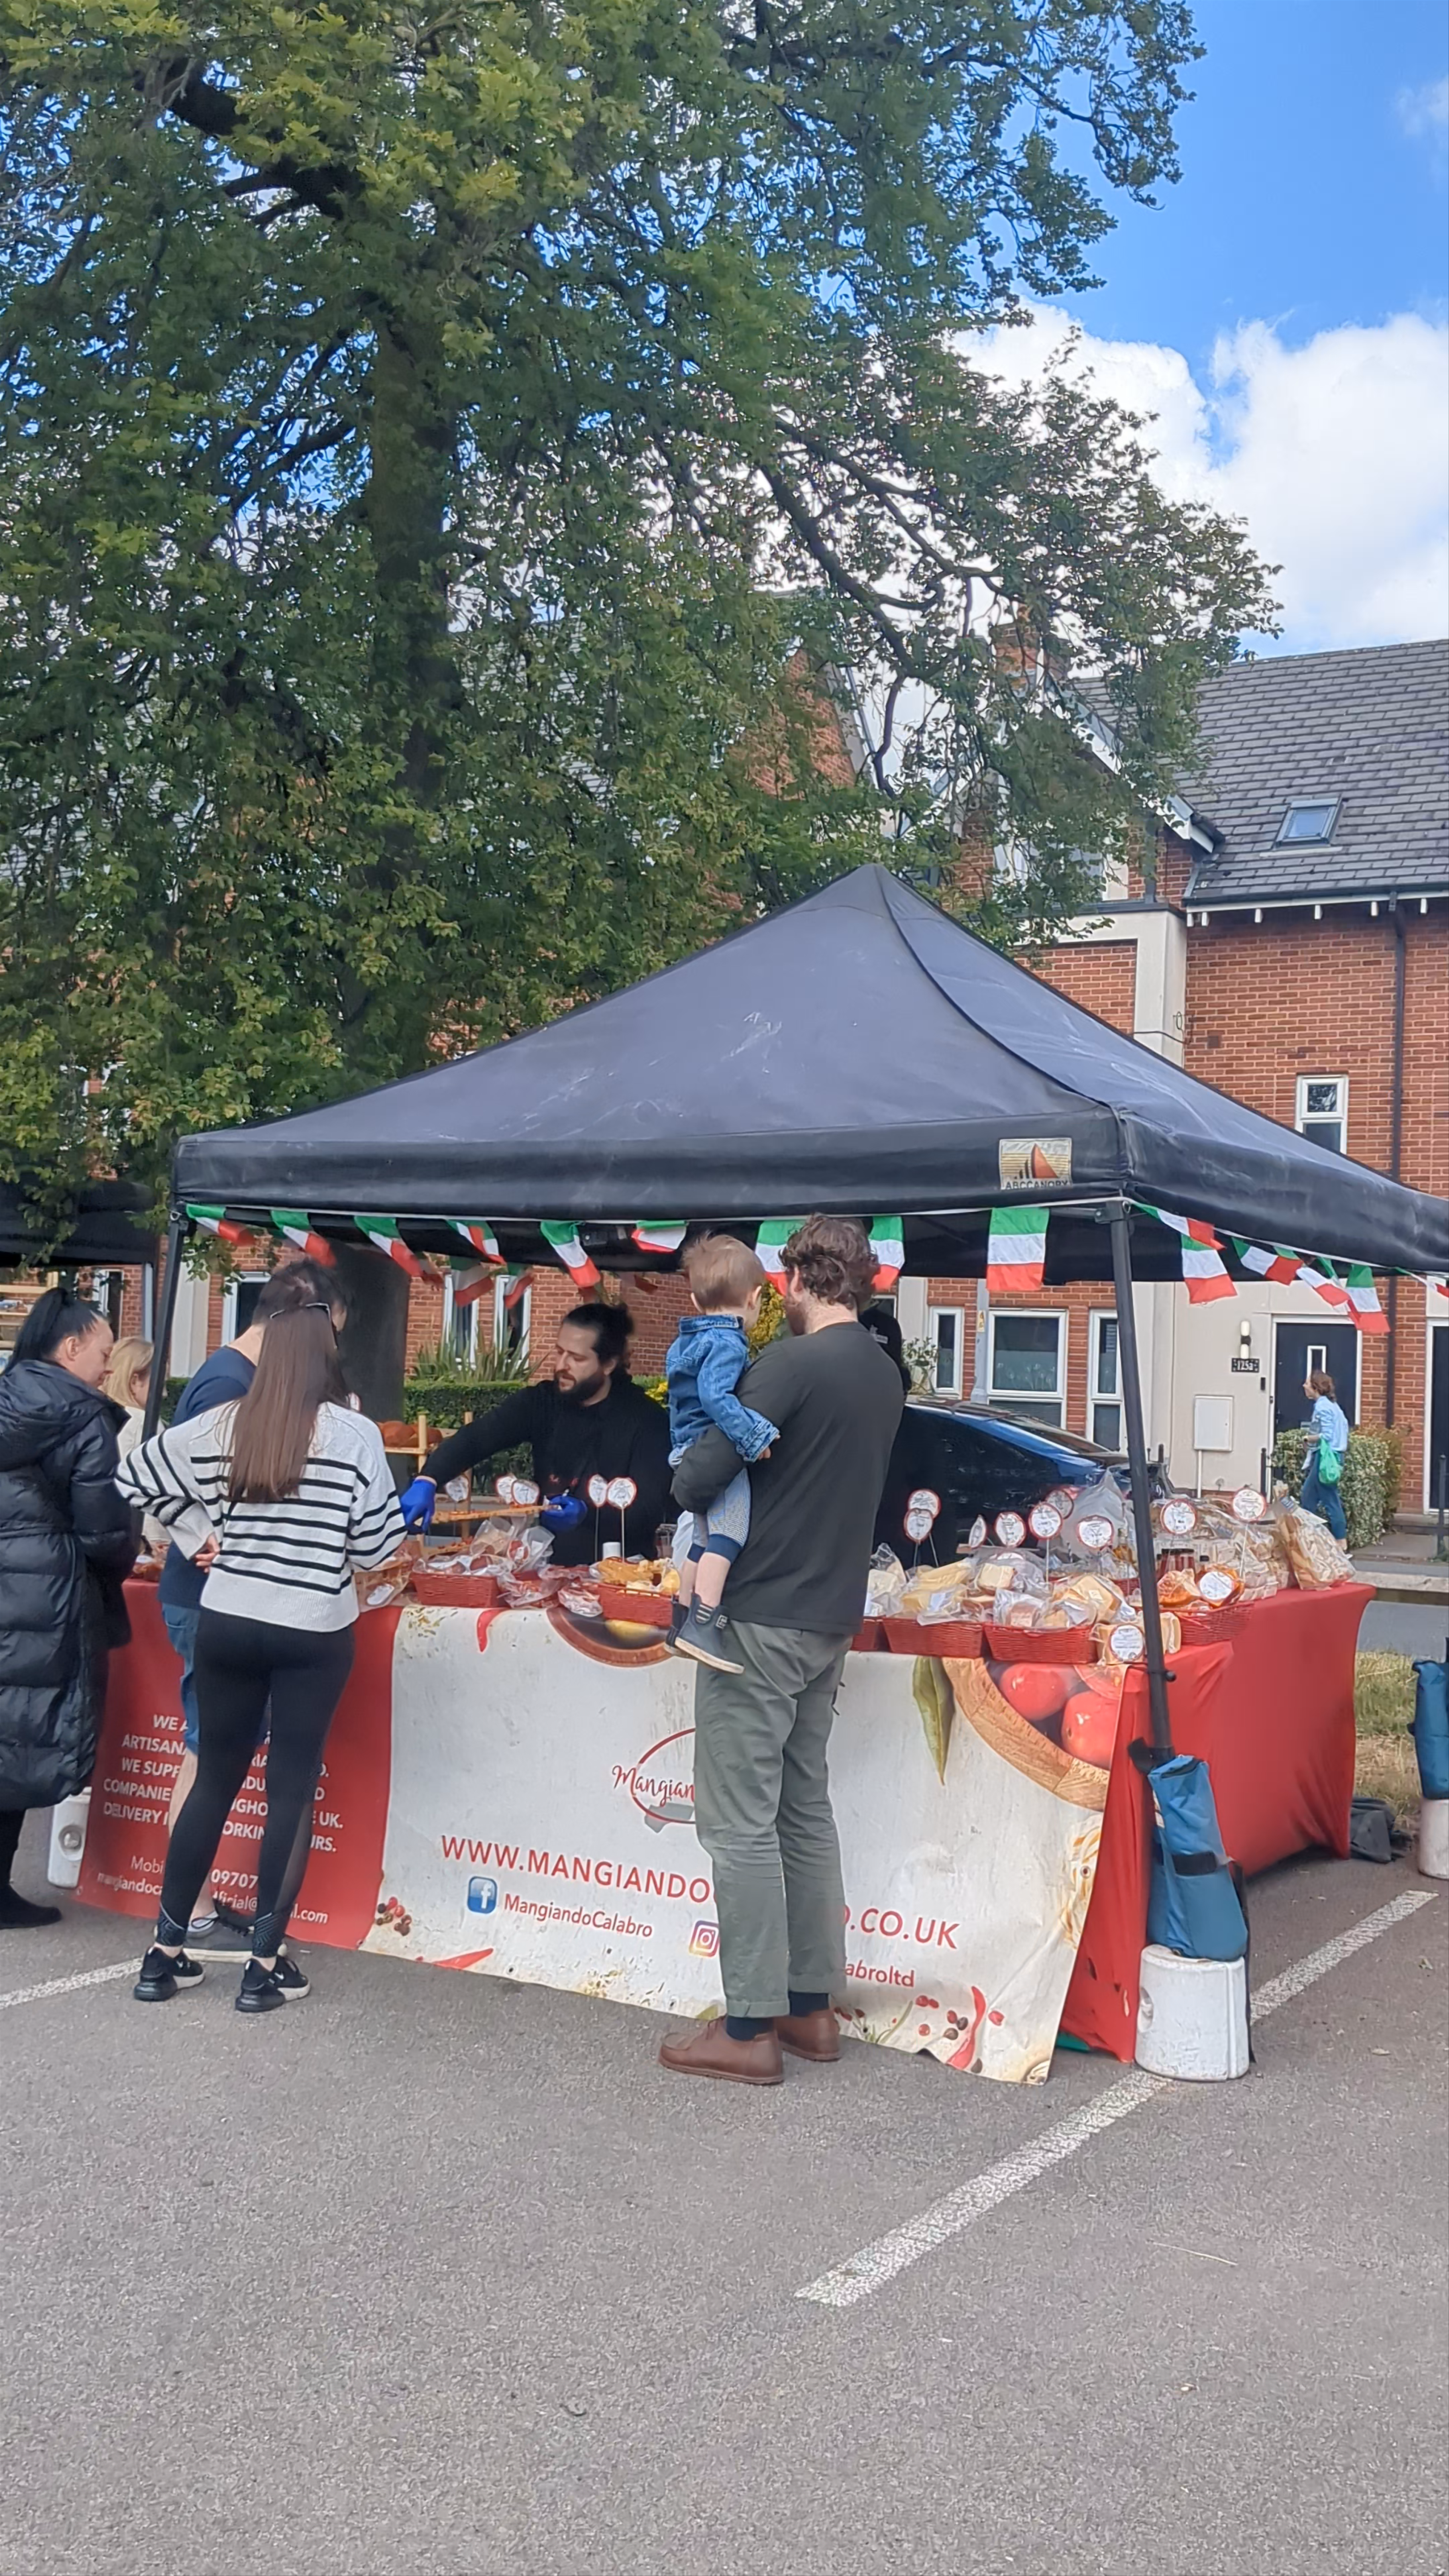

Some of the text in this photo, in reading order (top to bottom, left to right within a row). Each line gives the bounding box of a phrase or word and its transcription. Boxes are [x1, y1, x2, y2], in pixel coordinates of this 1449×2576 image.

[153, 1714, 179, 1731] WE
[122, 1757, 181, 1778] WE SUPP
[612, 1765, 695, 1807] Mangian
[103, 1778, 172, 1801] COMPANIE
[319, 1811, 343, 1829] UK.
[103, 1802, 162, 1824] DELIVERY
[222, 1821, 265, 1840] ORKIN
[131, 1855, 258, 1889] Mobi 09707
[441, 1835, 712, 1903] WWW.MANGIANDO
[505, 1893, 653, 1937] MangiandoCalabro
[845, 1905, 960, 1949] .CO.UK
[845, 1959, 915, 1987] abroltd
